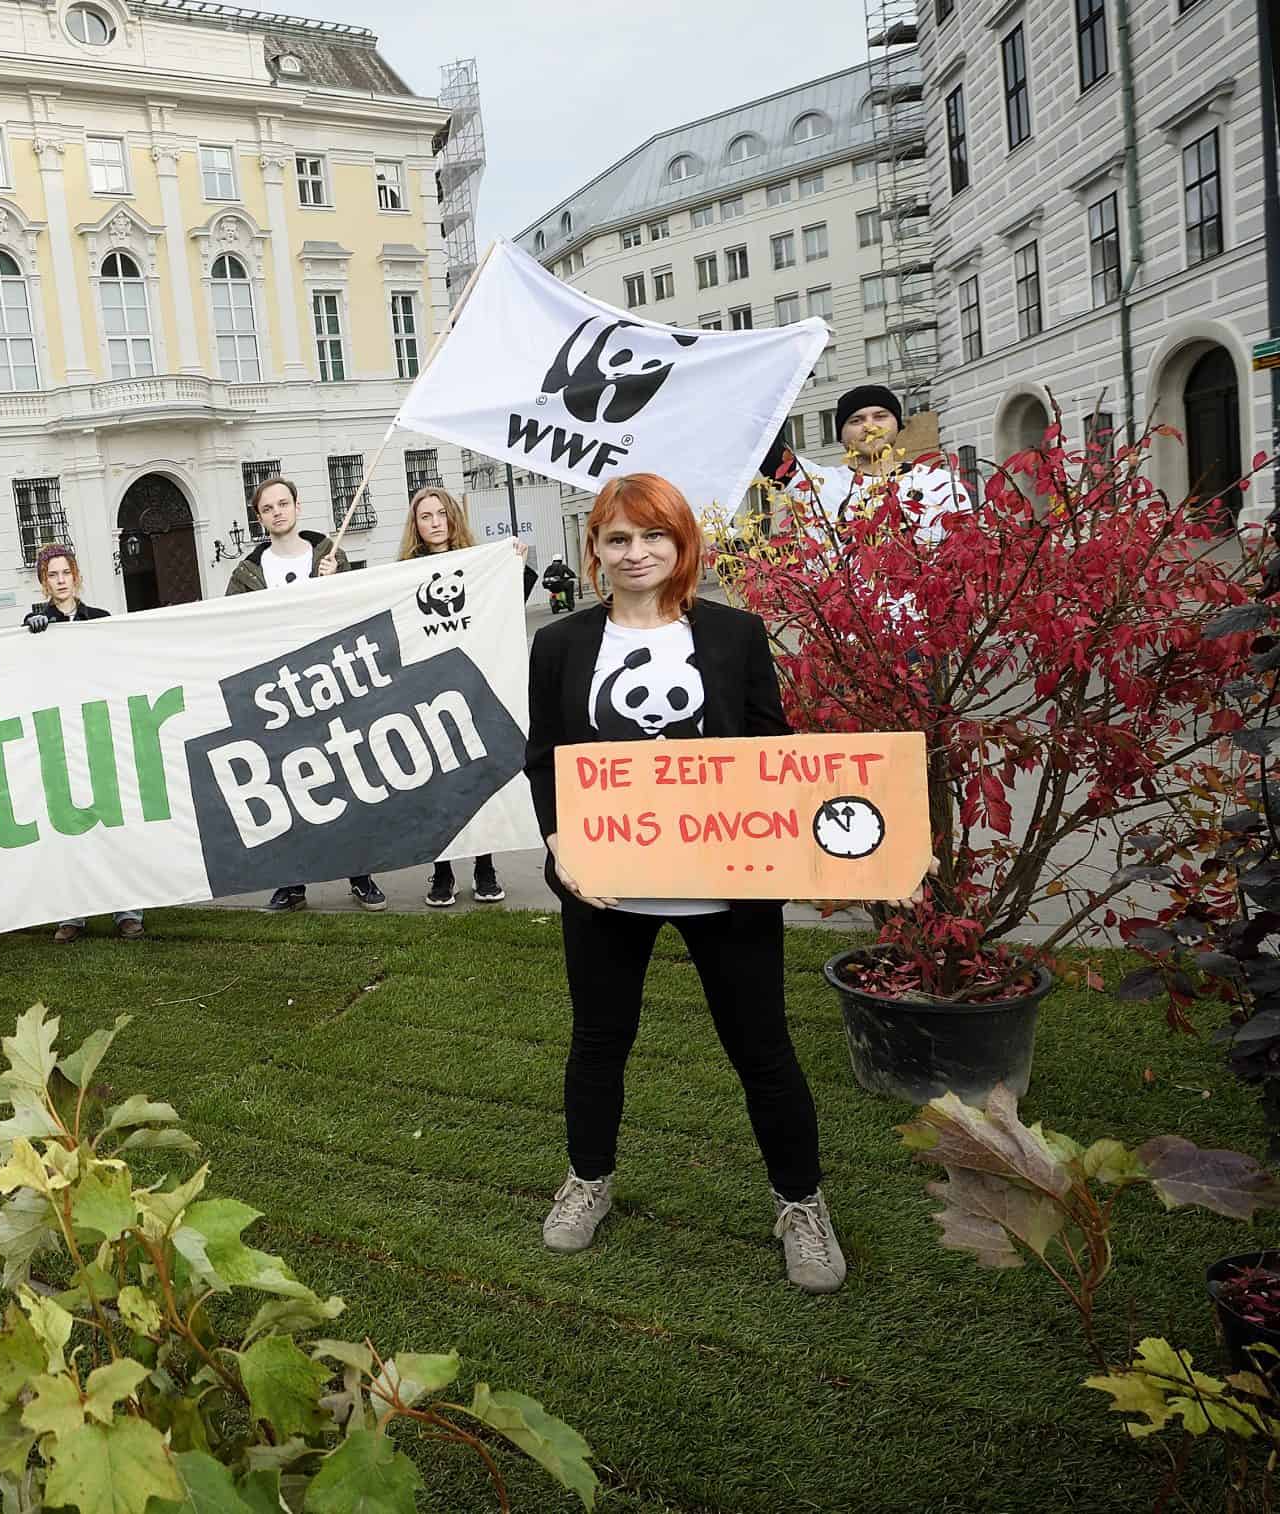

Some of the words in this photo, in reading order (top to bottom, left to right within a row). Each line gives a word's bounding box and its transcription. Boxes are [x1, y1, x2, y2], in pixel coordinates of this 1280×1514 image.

[497, 521, 533, 535] SAER
[423, 615, 472, 637] WWF
[254, 635, 393, 730] statt
[206, 690, 489, 849] Beton
[758, 749, 885, 786] LÄUFT
[582, 811, 662, 847] UNS
[678, 808, 800, 843] DAVON
